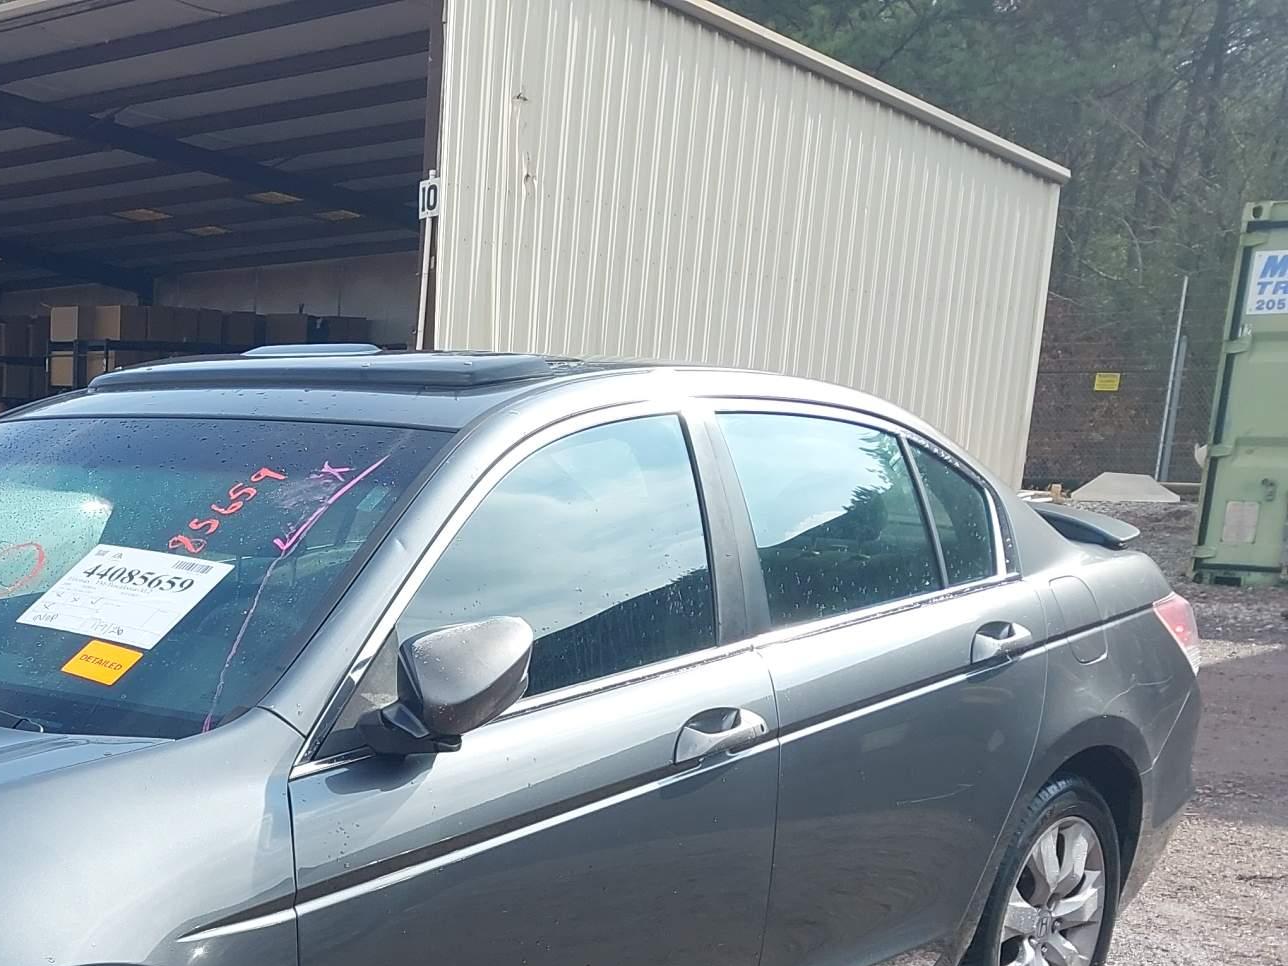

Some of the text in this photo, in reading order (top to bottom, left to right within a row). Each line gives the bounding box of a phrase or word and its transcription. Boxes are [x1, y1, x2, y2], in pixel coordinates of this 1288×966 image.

[422, 184, 438, 212] 10
[1255, 299, 1286, 311] 205
[168, 467, 287, 553] 85659
[83, 563, 195, 593] 44085659
[79, 654, 123, 671] DETAILED
